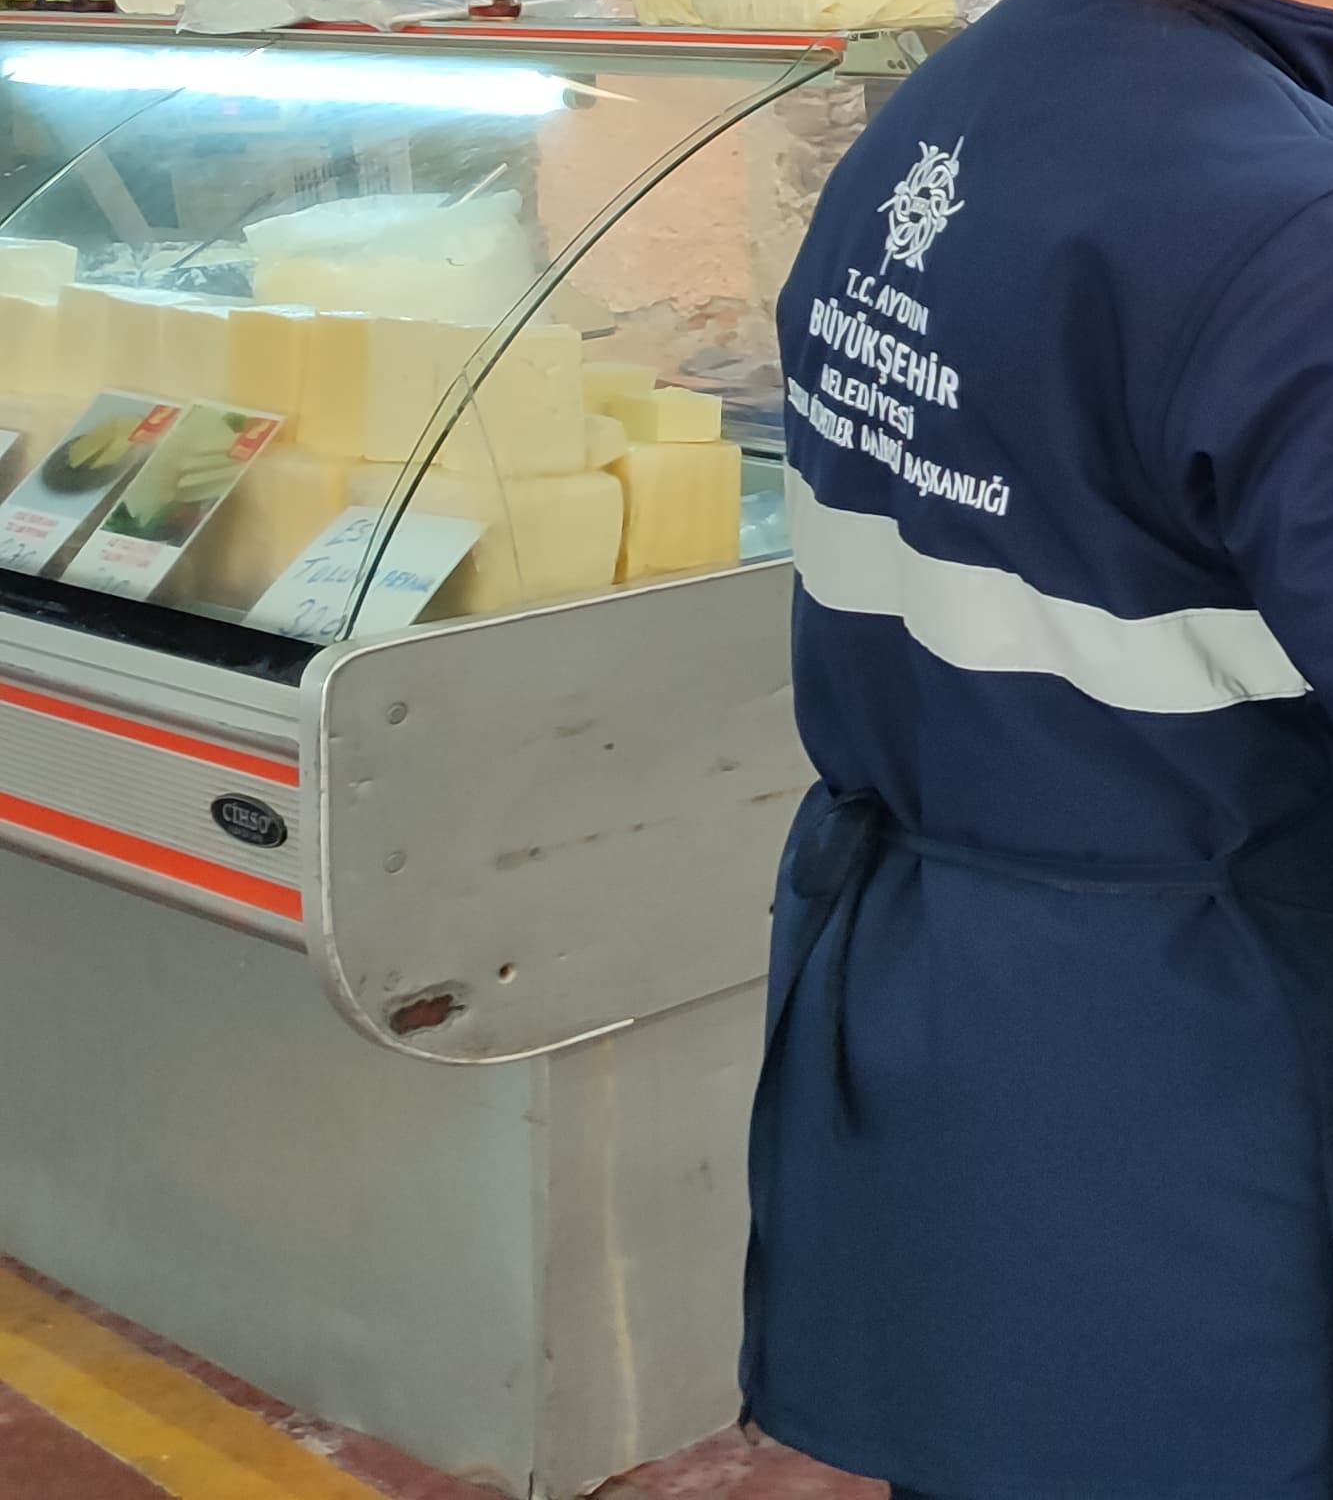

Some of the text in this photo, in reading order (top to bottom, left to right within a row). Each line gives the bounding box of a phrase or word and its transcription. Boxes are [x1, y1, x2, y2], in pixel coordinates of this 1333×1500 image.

[845, 268, 929, 335] T.C. AYDIN
[808, 297, 960, 410] BÜYÜKŞEHİR
[819, 363, 915, 440] BELEDİYESİ
[902, 451, 1010, 517] BAŞKANLIĞI
